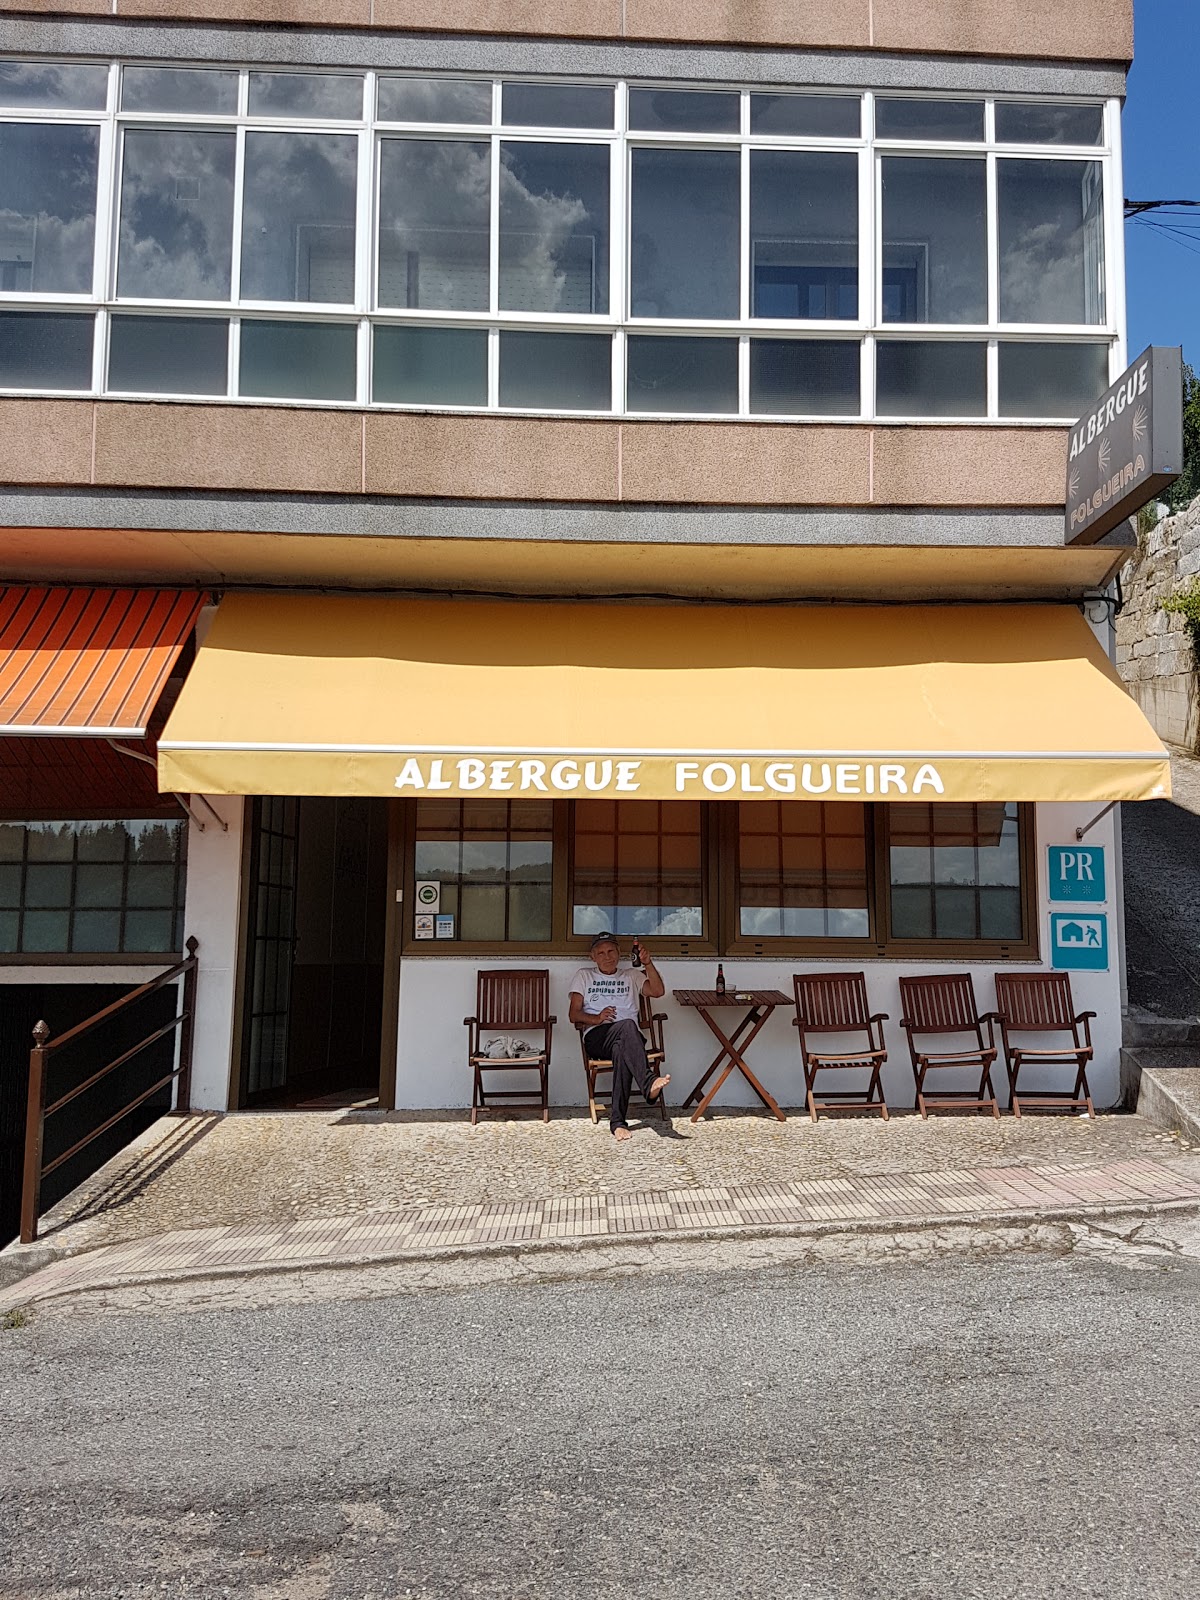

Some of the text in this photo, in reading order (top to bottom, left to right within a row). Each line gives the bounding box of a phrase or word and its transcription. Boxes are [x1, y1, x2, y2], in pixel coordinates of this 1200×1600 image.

[1069, 359, 1149, 462] ALBERGUE
[1070, 454, 1146, 530] FOLGUEIRA
[394, 757, 945, 794] ALBERGUE FOLGUEIRA
[1059, 852, 1095, 881] PR
